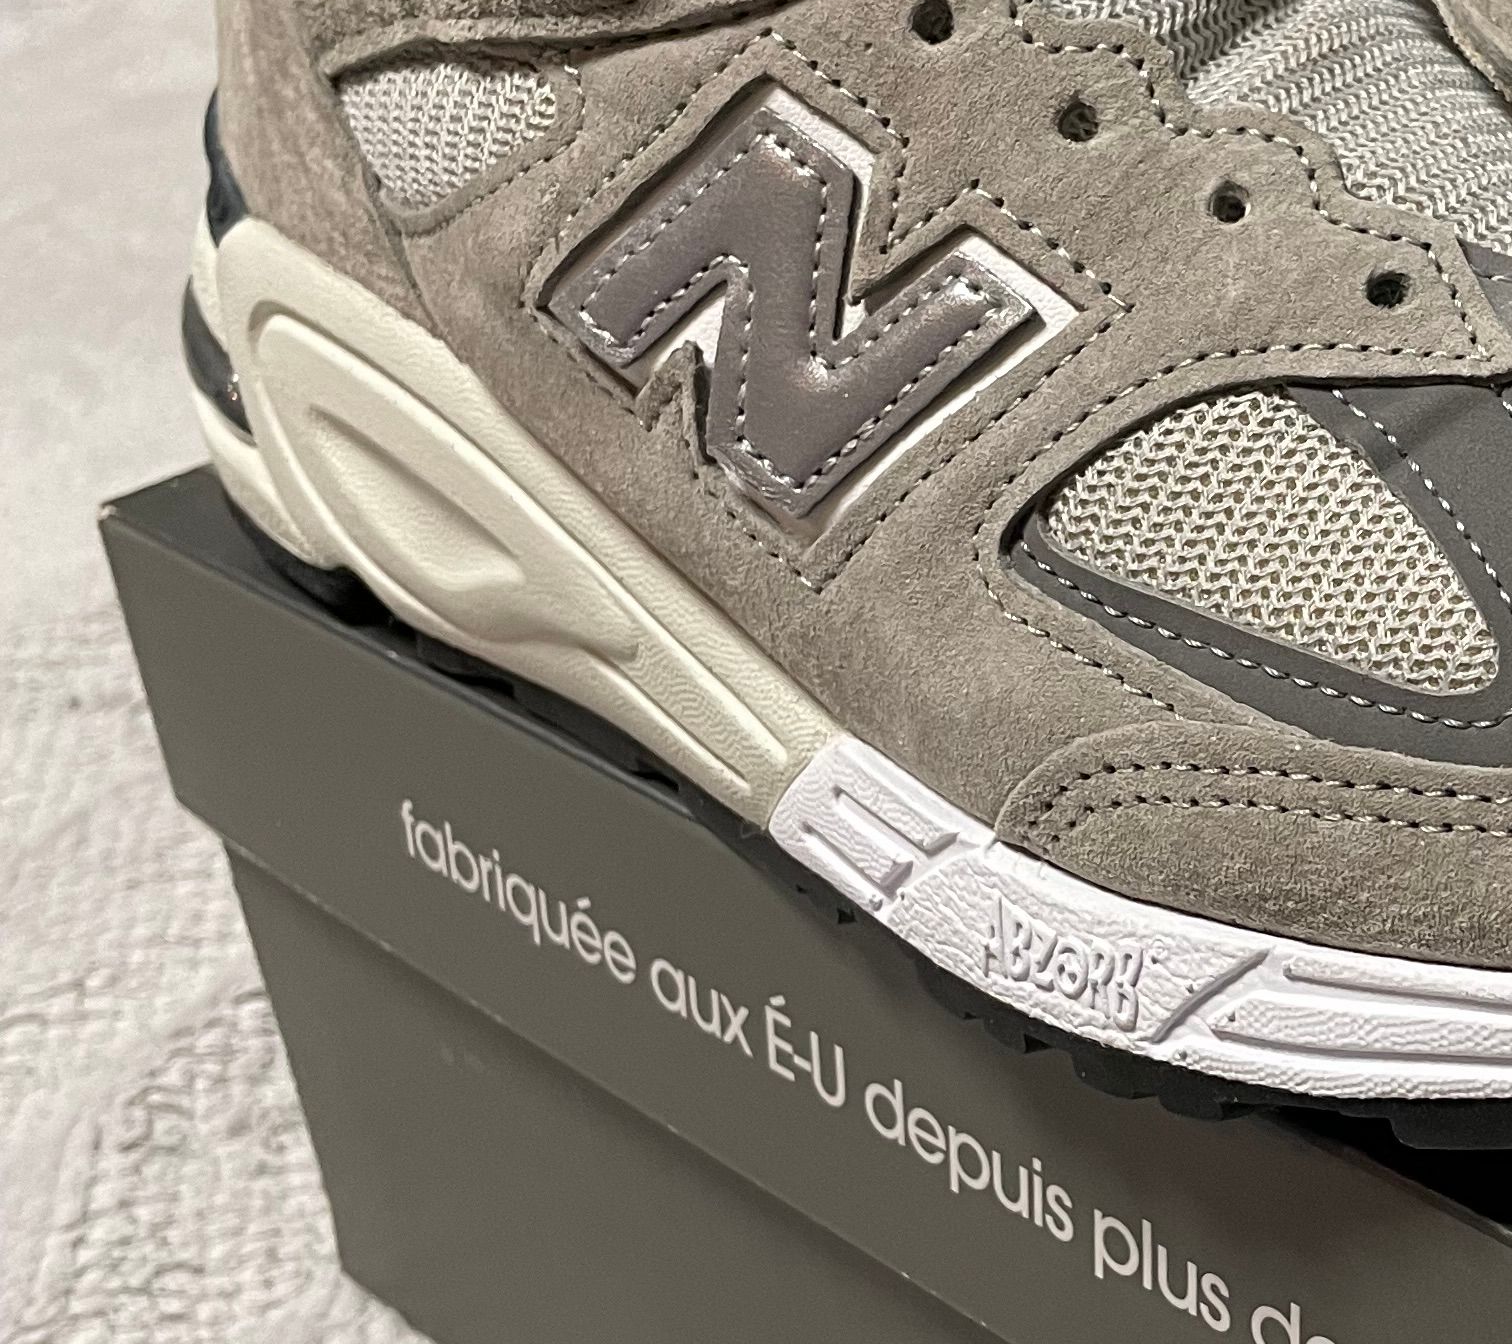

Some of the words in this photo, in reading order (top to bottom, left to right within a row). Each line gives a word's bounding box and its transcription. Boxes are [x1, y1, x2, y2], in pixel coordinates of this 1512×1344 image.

[535, 73, 1085, 546] N
[400, 799, 637, 984] fabriquée
[650, 958, 755, 1058] aux
[764, 995, 847, 1108] É-U
[864, 1078, 1075, 1244] depuis
[1093, 1208, 1232, 1333] plus
